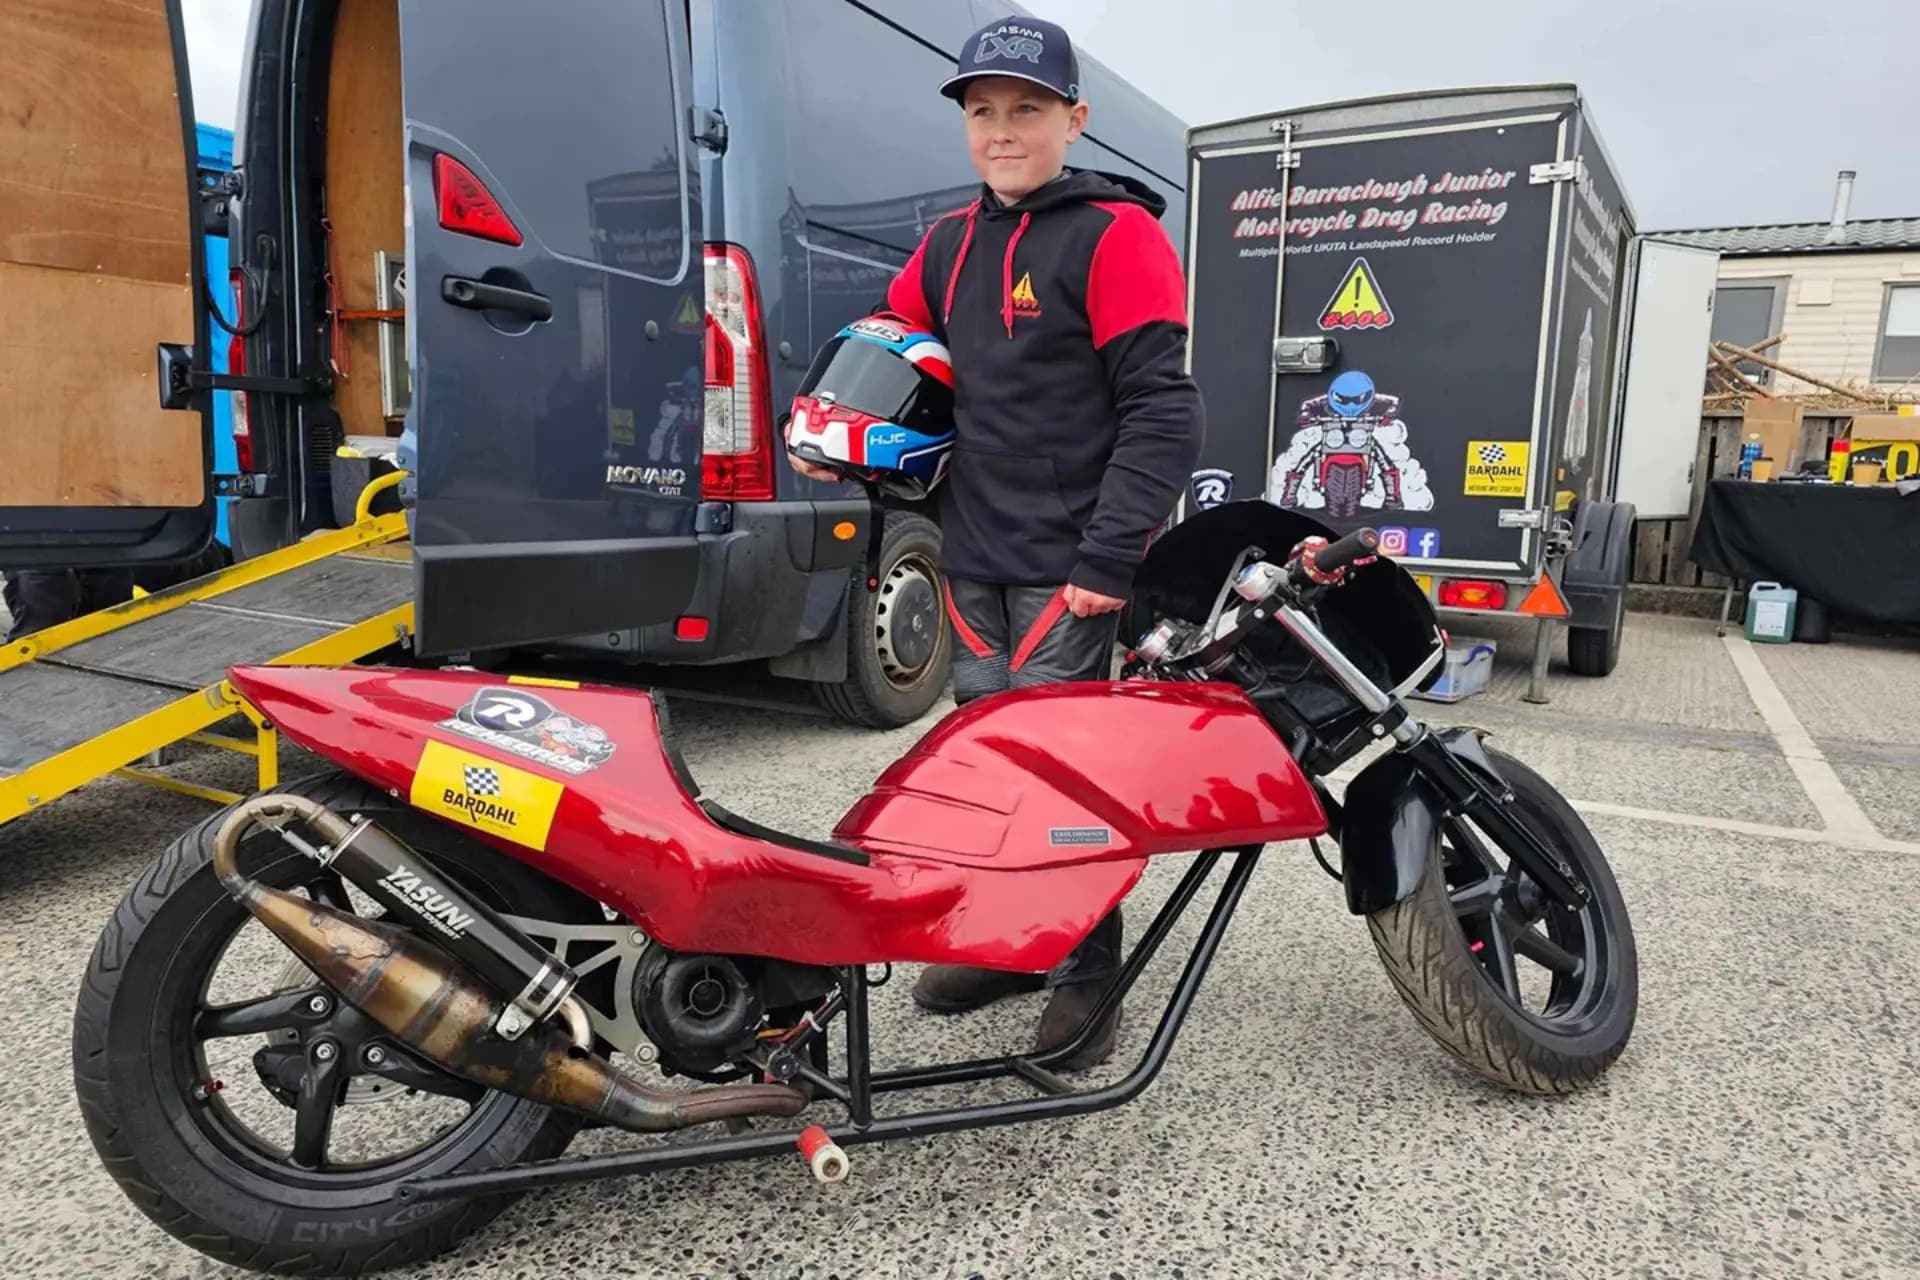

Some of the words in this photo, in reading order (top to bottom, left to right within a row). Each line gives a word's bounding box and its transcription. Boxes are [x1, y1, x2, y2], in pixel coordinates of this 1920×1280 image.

[980, 25, 1044, 41] PLASMA
[1231, 187, 1282, 211] Alfie
[1288, 174, 1428, 206] Barraclough
[1430, 168, 1516, 194] Junior
[1358, 207, 1418, 232] Drag
[1420, 198, 1508, 226] Racing
[1349, 238, 1410, 251] Landspeed
[1411, 234, 1454, 247] Record
[1456, 232, 1497, 244] Holder
[870, 432, 906, 445] HJC
[606, 465, 686, 486] MOVANO
[1469, 465, 1524, 477] BARDAHL
[442, 788, 518, 827] BARDAHL
